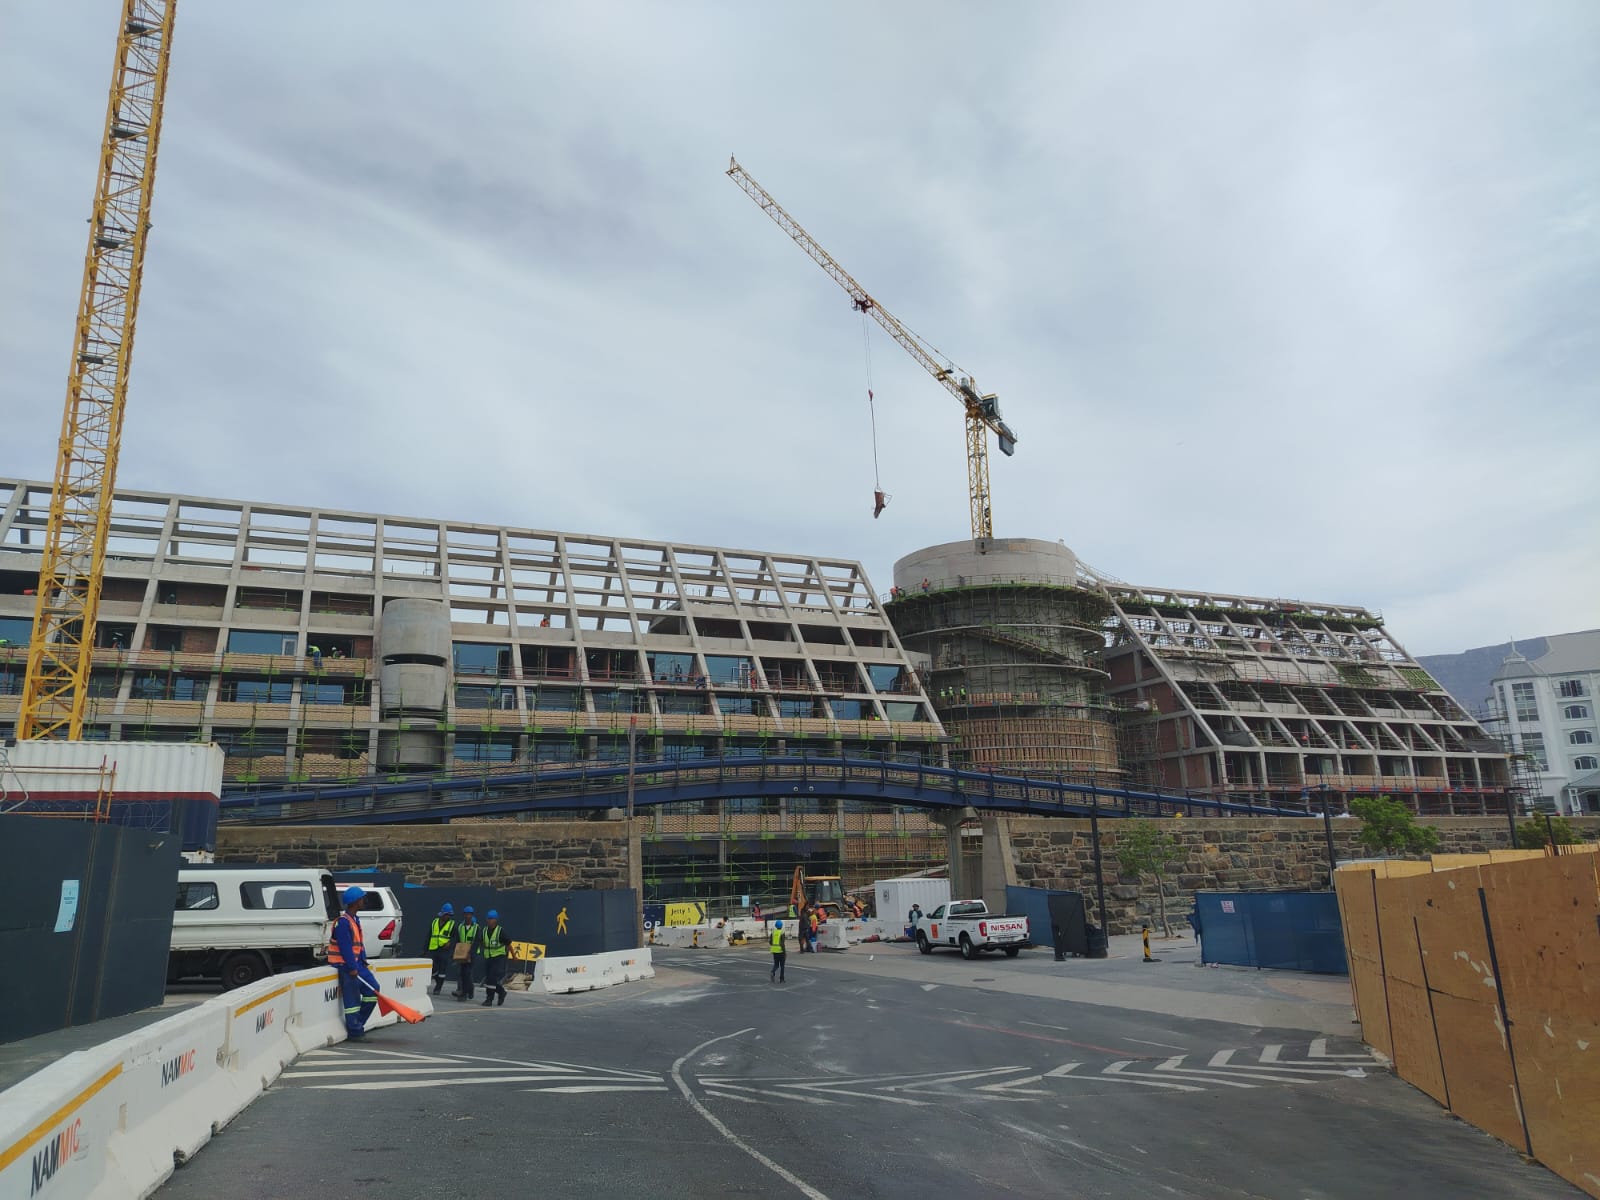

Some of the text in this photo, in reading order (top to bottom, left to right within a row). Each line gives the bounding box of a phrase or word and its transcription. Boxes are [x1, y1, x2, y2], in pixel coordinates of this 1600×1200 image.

[671, 908, 685, 916] Jetty
[990, 923, 1023, 932] NISSAN
[161, 1048, 196, 1089] NAMMIC
[30, 1117, 81, 1199] NAMMIC
